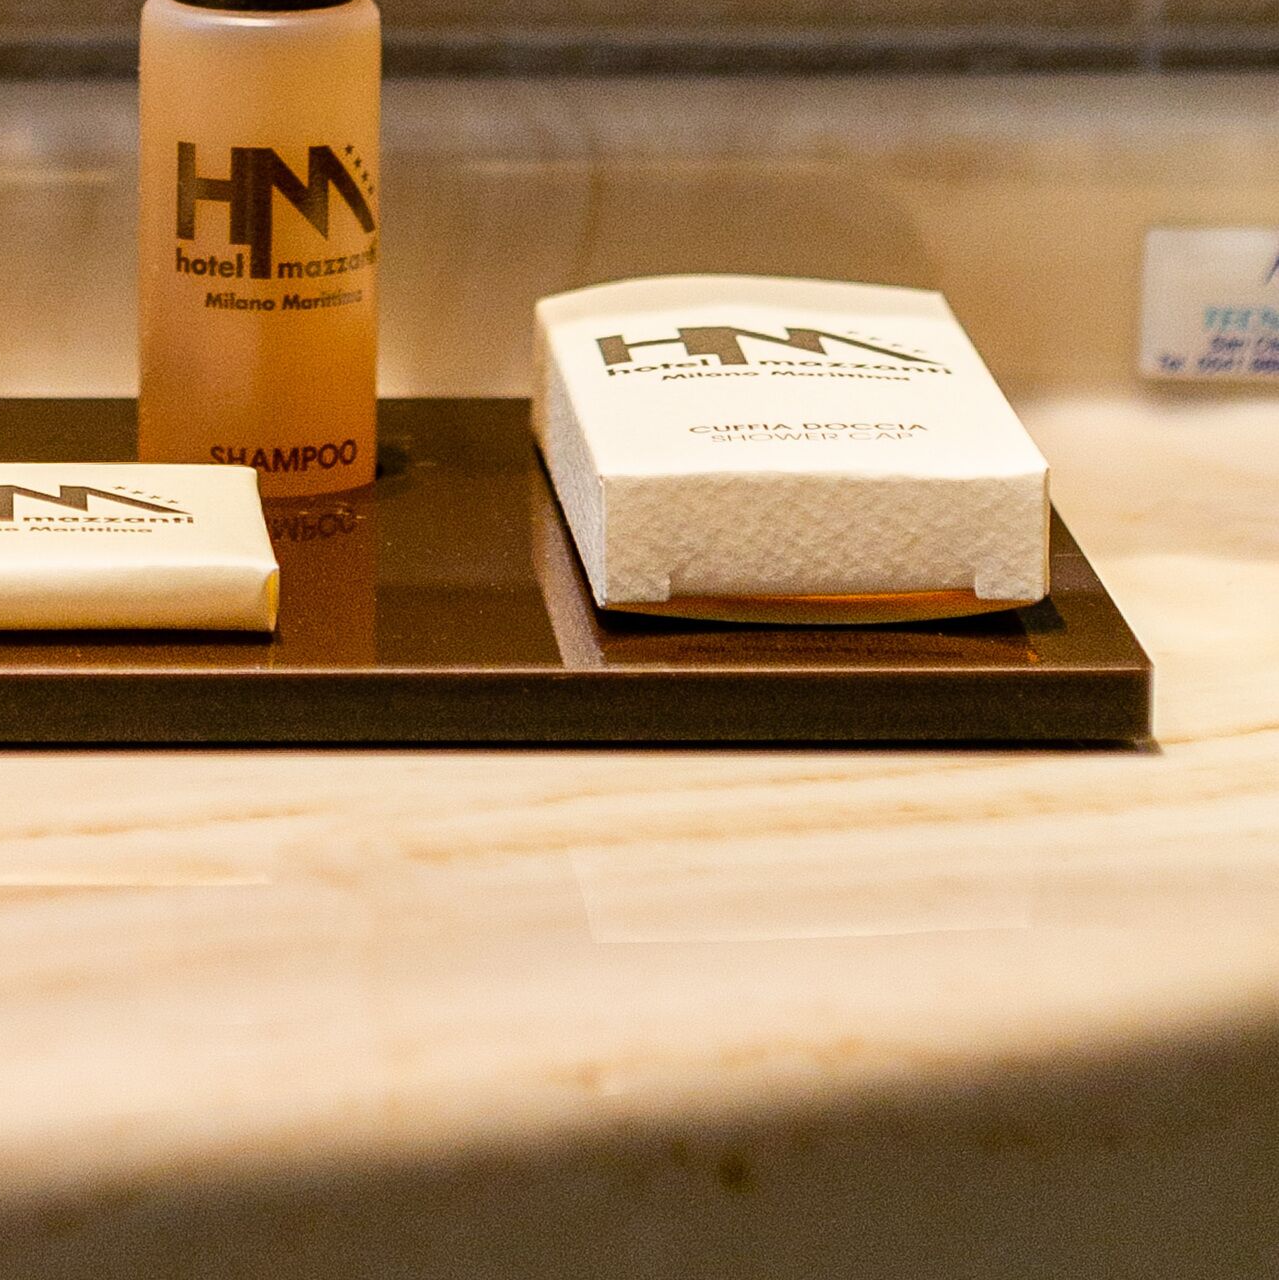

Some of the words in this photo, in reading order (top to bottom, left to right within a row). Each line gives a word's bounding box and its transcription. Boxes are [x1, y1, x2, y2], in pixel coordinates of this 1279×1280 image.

[176, 248, 244, 278] hotel
[277, 237, 377, 278] mazza
[204, 292, 275, 311] Milano
[607, 359, 710, 376] hotel
[759, 359, 953, 375] mazzanti
[662, 370, 760, 381] Milano
[689, 423, 793, 433] CUFFIA
[802, 423, 929, 431] DOCCIA
[711, 432, 839, 443] SHOWER
[849, 432, 914, 440] CAP
[210, 440, 357, 473] SHAMPOO
[22, 515, 194, 524] mazzanti
